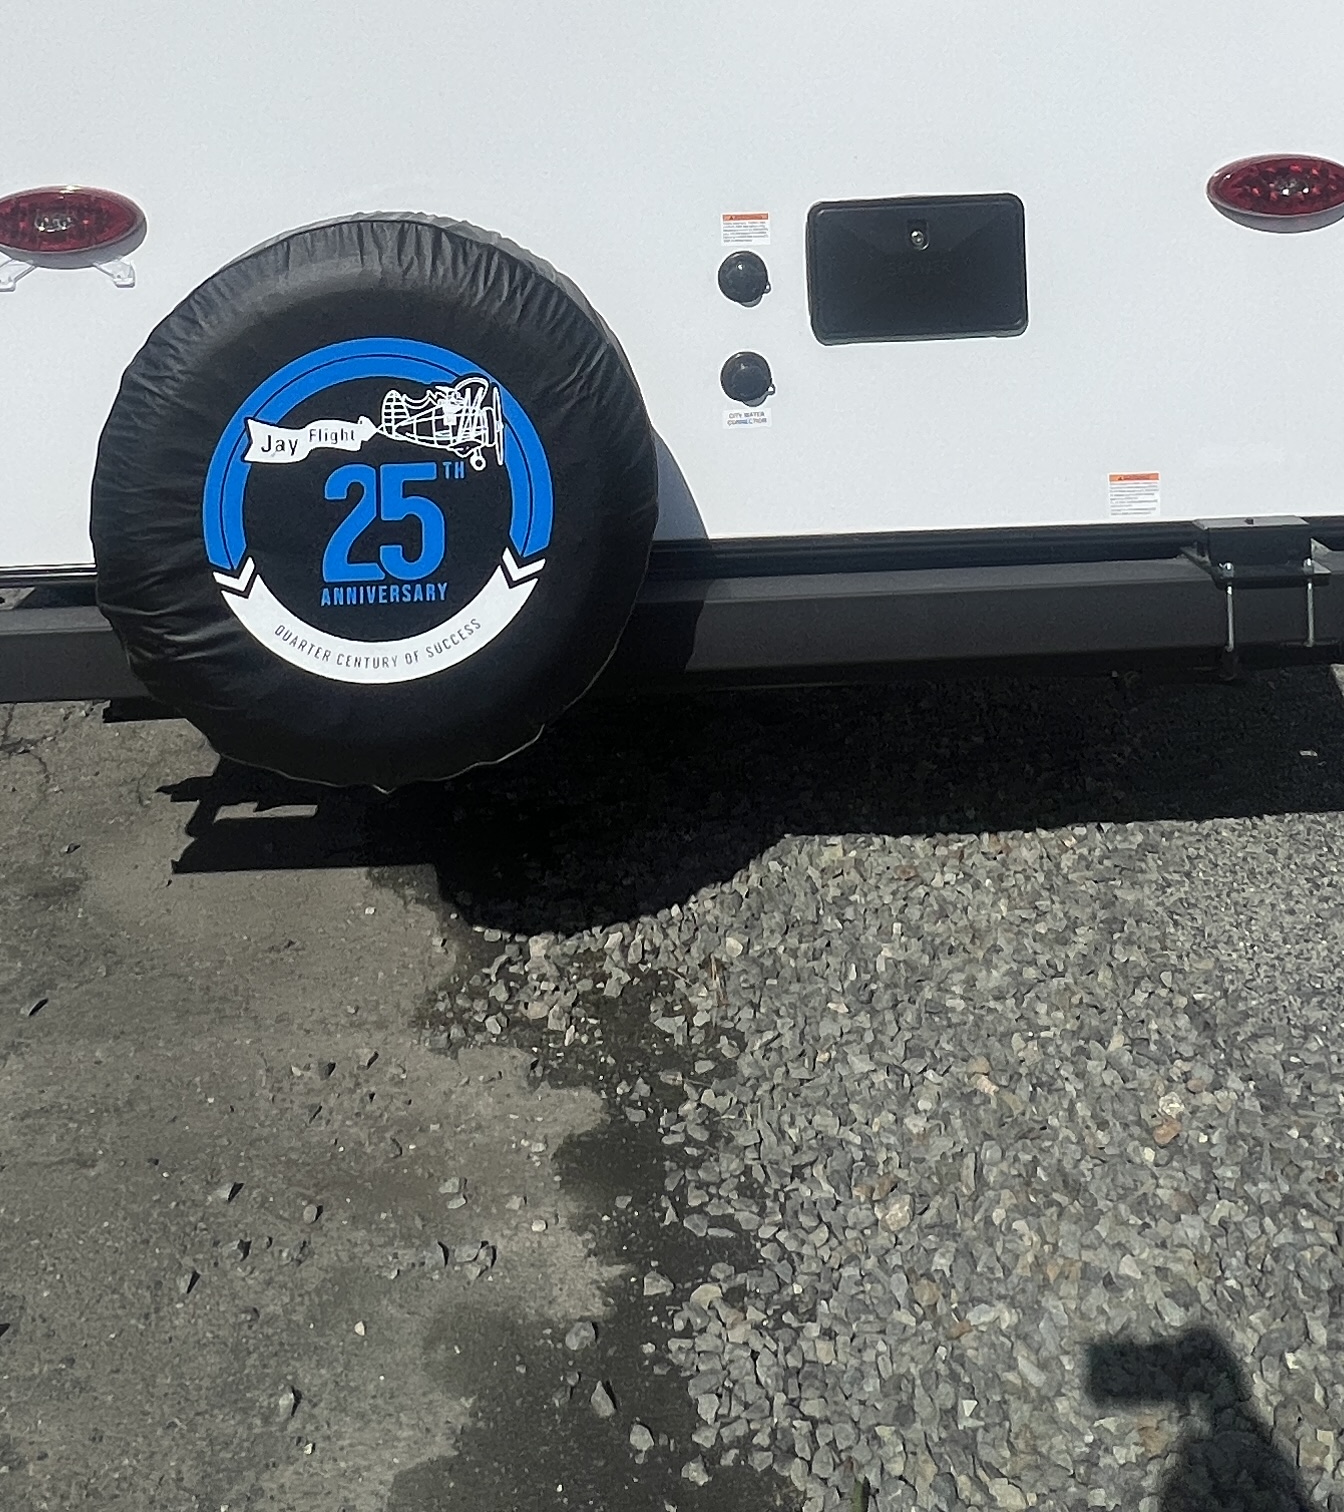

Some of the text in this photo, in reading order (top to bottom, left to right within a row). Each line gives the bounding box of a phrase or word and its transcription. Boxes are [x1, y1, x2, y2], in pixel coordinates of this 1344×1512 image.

[727, 417, 767, 426] COCTIO
[260, 427, 356, 457] Jay Flight
[320, 583, 448, 606] ANNIVERSARY
[274, 617, 482, 670] QUARTER CENTURY OF SUCCESS
